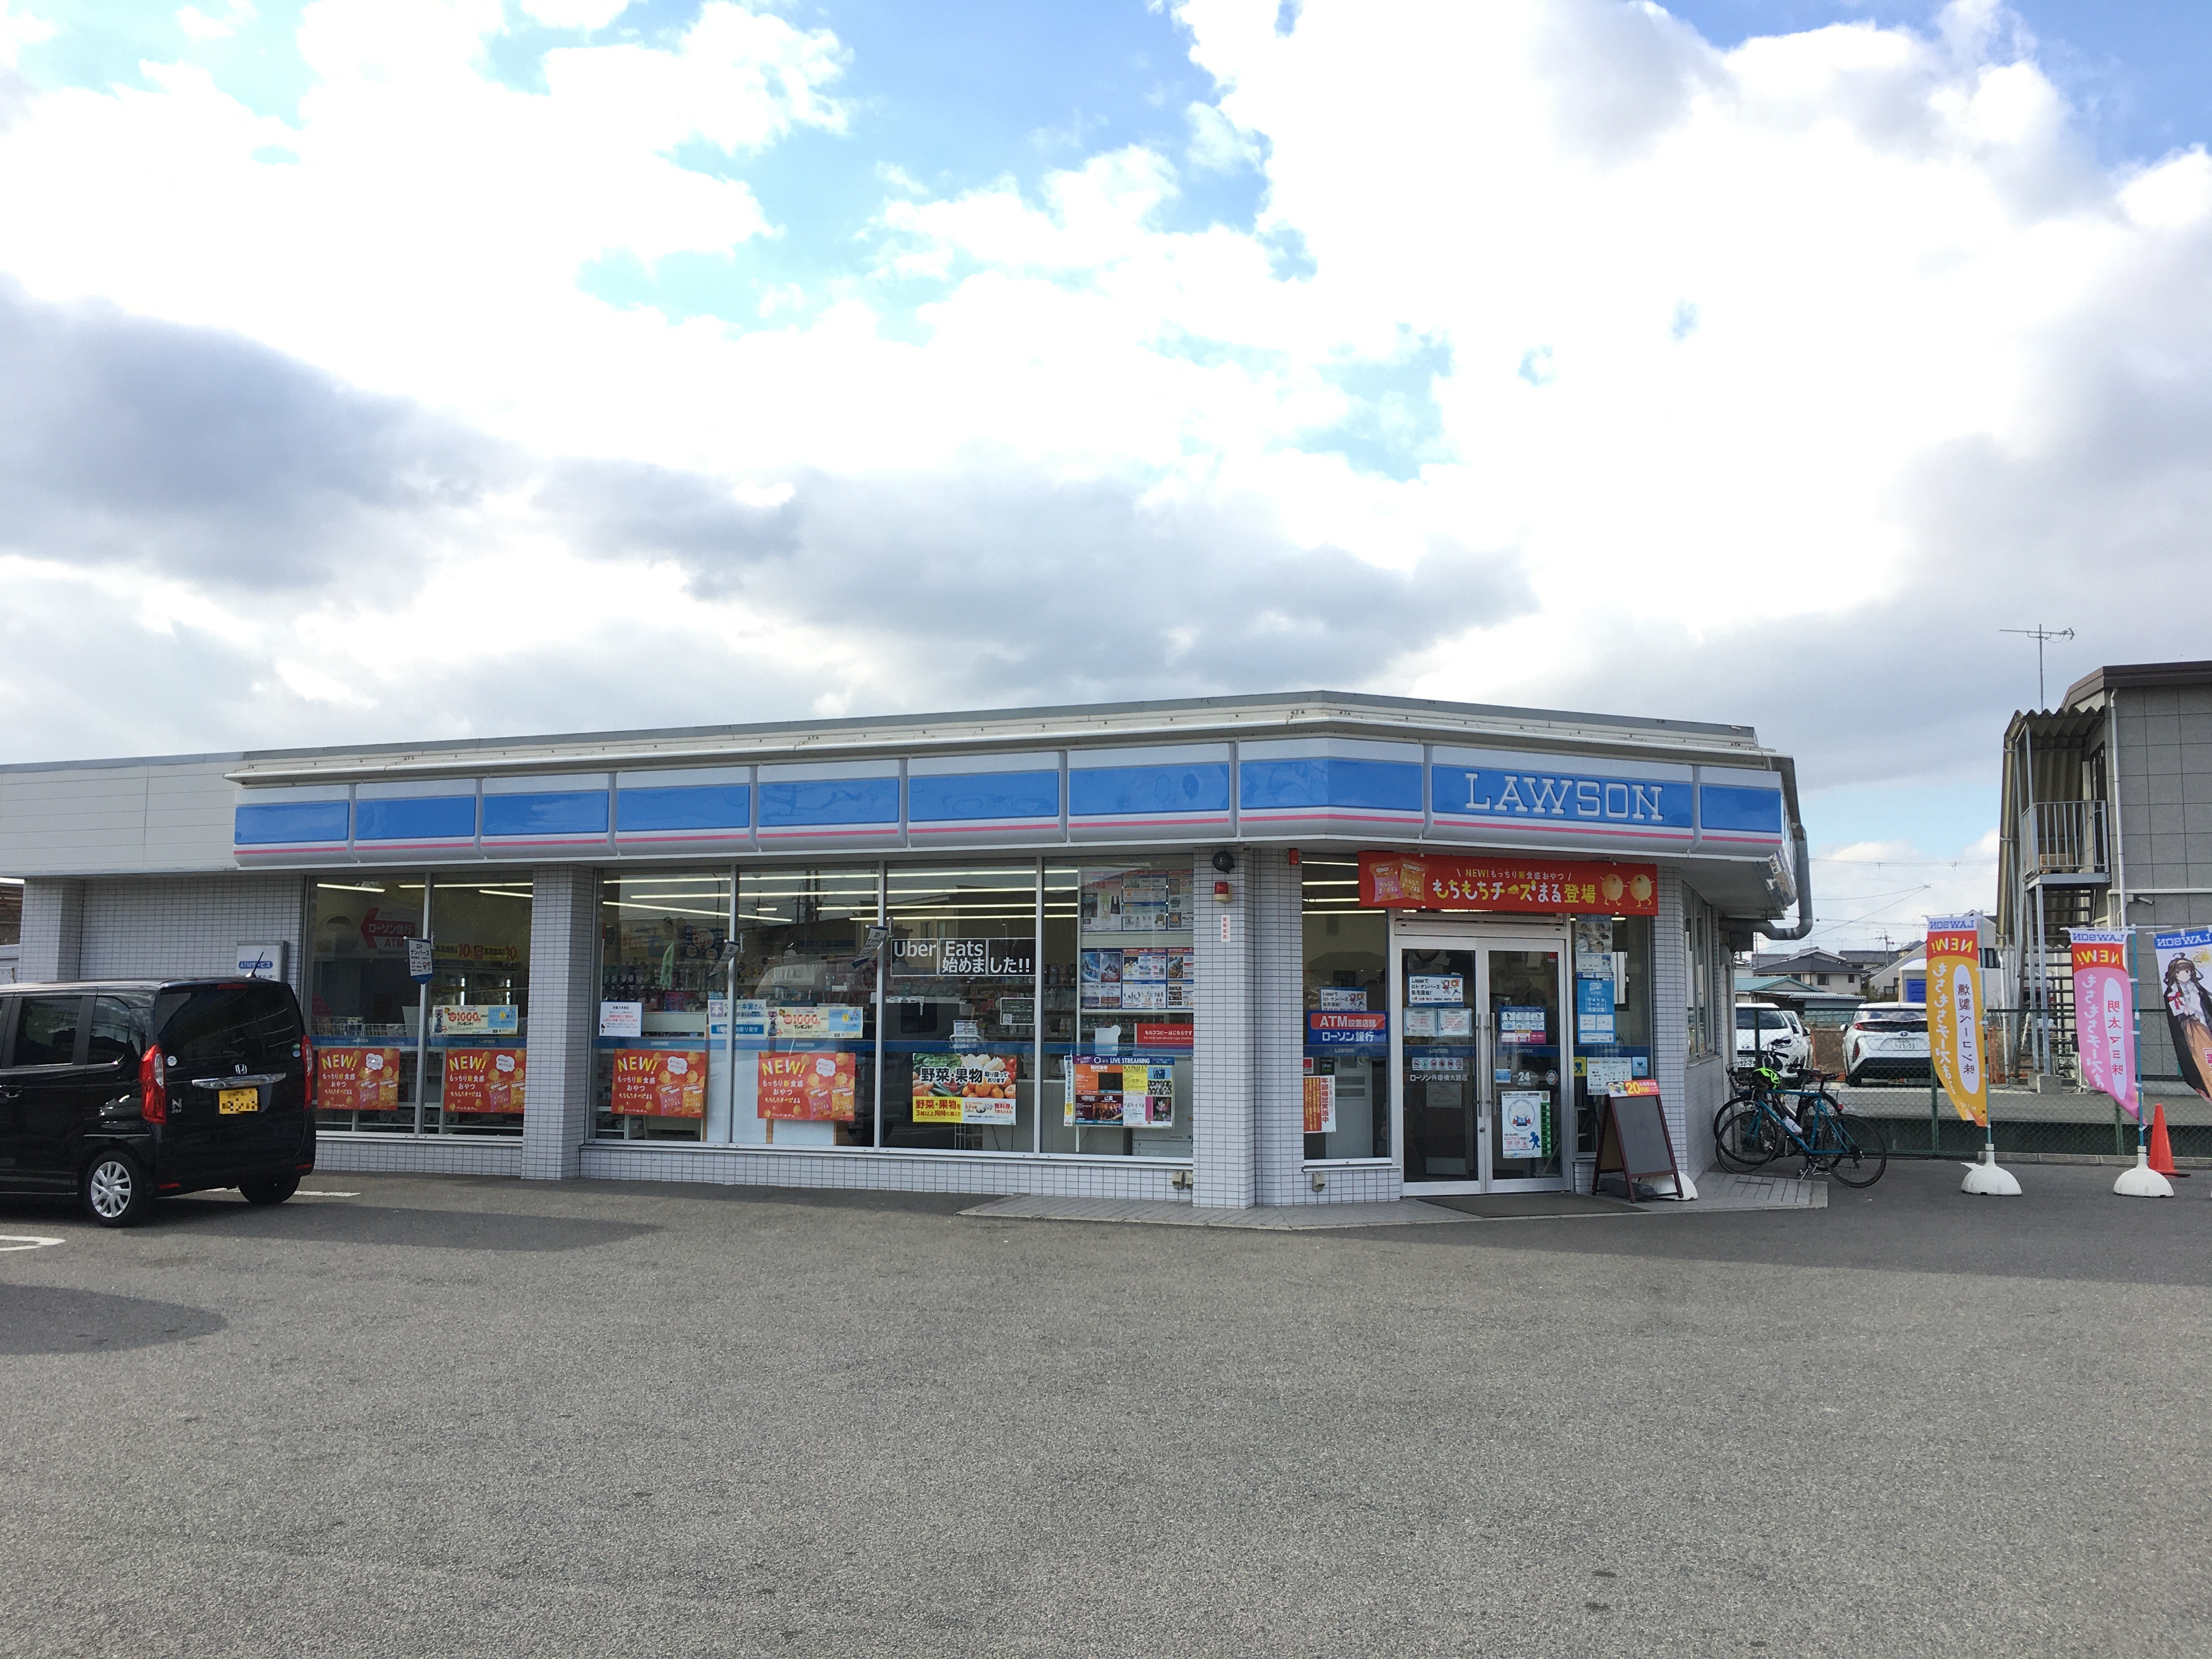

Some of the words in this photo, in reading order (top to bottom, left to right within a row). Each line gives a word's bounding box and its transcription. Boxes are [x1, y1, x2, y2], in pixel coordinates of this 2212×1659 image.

[1465, 772, 1663, 821] LAWSON
[1465, 868, 1489, 878] NEW!
[384, 938, 404, 949] ATM
[894, 940, 937, 957] Uber
[945, 940, 984, 957] Eats
[942, 957, 1030, 973] 始めました!!
[1322, 1031, 1374, 1042] ローソン銀行
[321, 1054, 358, 1071] NEW!
[449, 1056, 487, 1073] NEW!
[617, 1056, 658, 1075] NEW!
[761, 1059, 806, 1077] NEW!
[921, 1068, 984, 1083] 野菜・果物
[1518, 1071, 1531, 1081] 24
